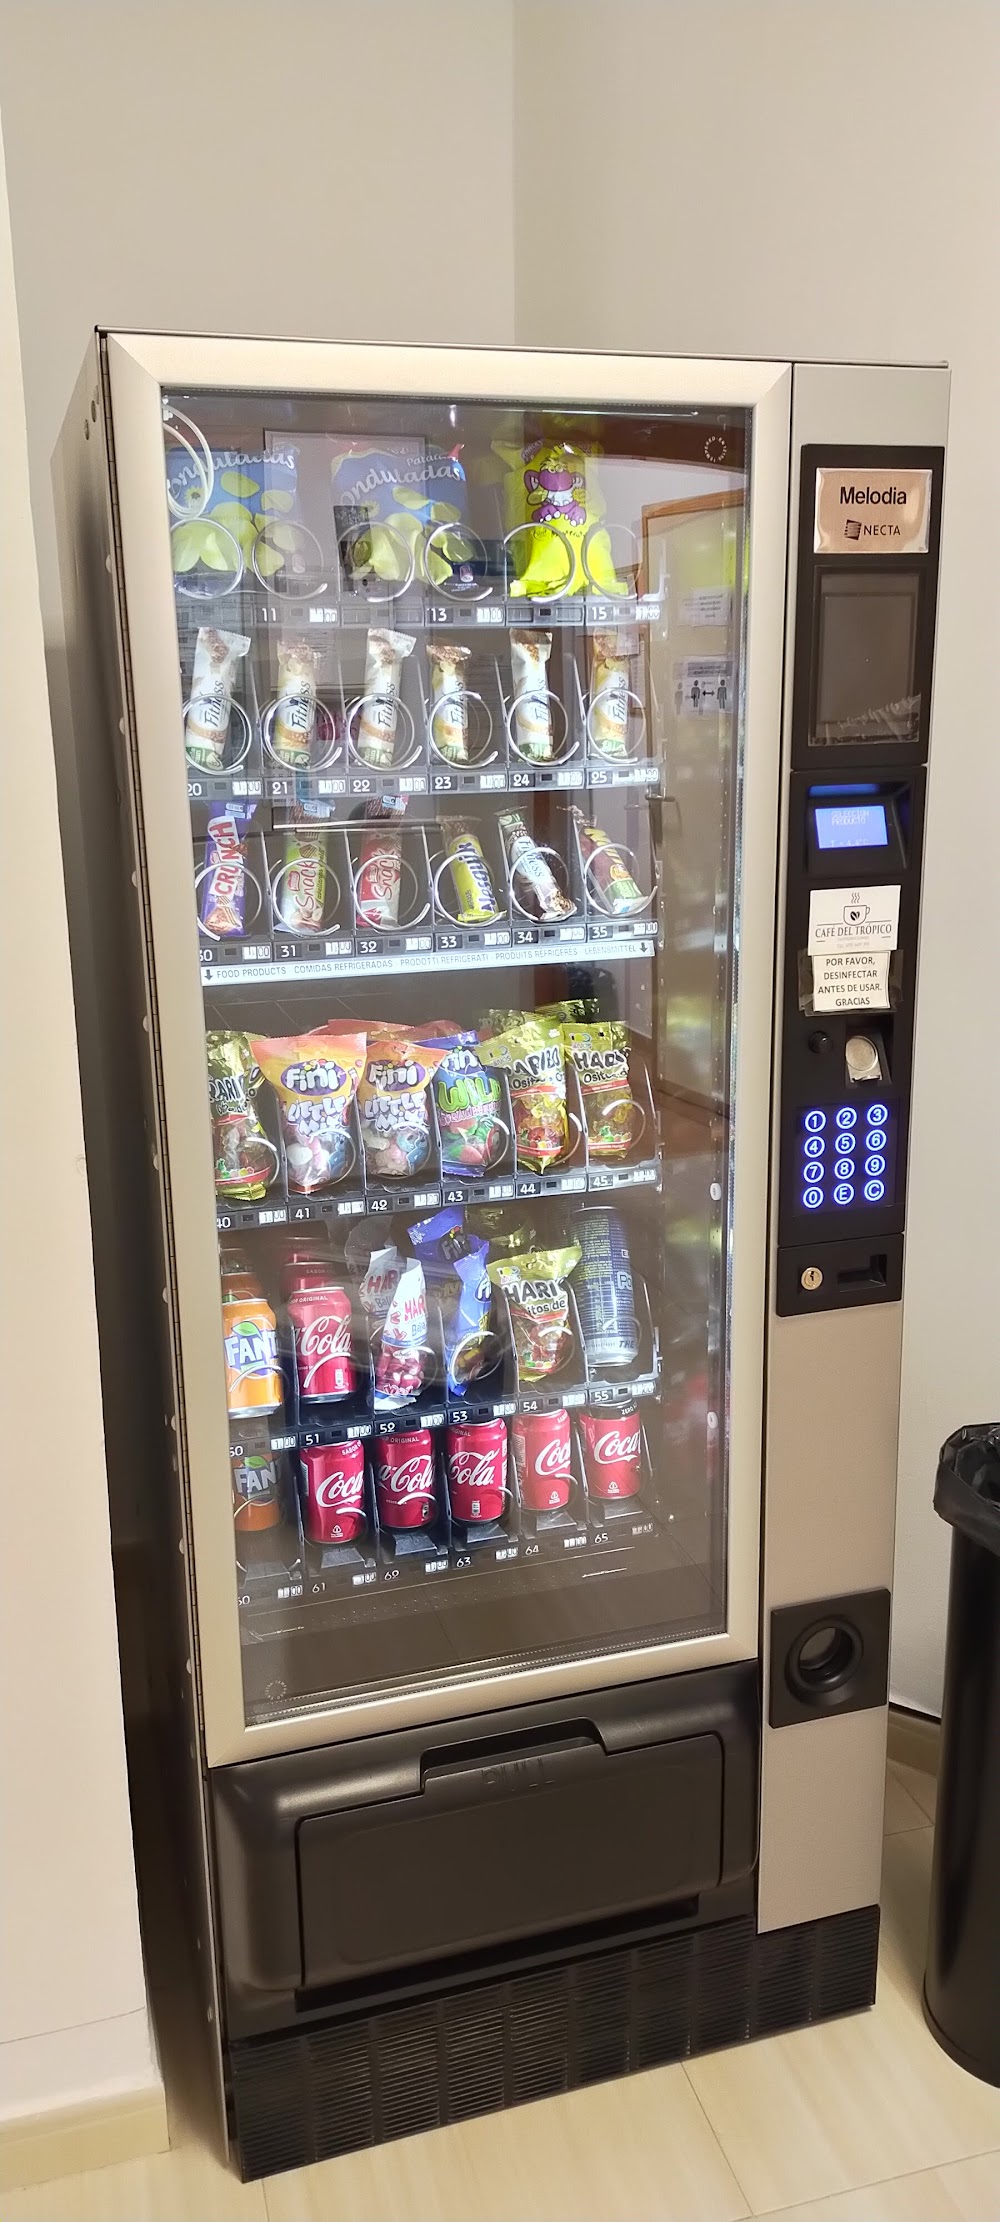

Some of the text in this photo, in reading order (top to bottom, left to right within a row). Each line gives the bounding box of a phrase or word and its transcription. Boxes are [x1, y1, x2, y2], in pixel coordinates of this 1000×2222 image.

[839, 486, 907, 505] Melodia
[864, 524, 901, 536] NECTA
[262, 607, 277, 622] 11
[430, 607, 448, 622] 13
[591, 607, 607, 620] 15
[435, 776, 451, 790] 23
[513, 773, 530, 787] 24
[591, 771, 607, 784] 25
[272, 782, 288, 794] 21
[353, 780, 370, 793] 22
[209, 821, 240, 895] CRUNCH
[374, 856, 394, 901] Snac
[592, 927, 607, 938] 35
[815, 922, 892, 938] CAFÉ DEL TRÓPICO
[440, 936, 457, 949] 33
[517, 931, 533, 944] 34
[281, 945, 296, 957] 31
[360, 941, 377, 953] 32
[216, 969, 239, 979] FOOD
[242, 967, 286, 977] PRODUCTS
[294, 963, 332, 974] COMIDAS
[334, 960, 393, 971] REFRIGERADAS
[400, 957, 439, 967] PRODOTTI
[441, 953, 489, 964] REFRIGERATI
[495, 949, 533, 960] PRODUITS
[585, 943, 636, 955] LEBENSMITTEL
[825, 956, 876, 967] POR FAVOR,
[823, 970, 878, 980] DESINFECTAR
[818, 983, 882, 993] ANTES DE USAR.
[835, 997, 870, 1006] GRACIAS
[286, 1063, 338, 1092] Fini
[369, 1063, 418, 1090] Fini
[438, 1078, 501, 1113] WILD
[287, 1092, 347, 1122] LITTLE
[364, 1091, 426, 1119] LITTLE
[842, 1112, 851, 1125] 2
[873, 1108, 882, 1121] 3
[812, 1115, 818, 1127] 1
[841, 1137, 850, 1150] 5
[872, 1134, 880, 1146] 6
[810, 1141, 819, 1153] 4
[840, 1162, 849, 1175] 8
[870, 1159, 879, 1172] 9
[809, 1166, 818, 1178] 7
[593, 1176, 607, 1187] 45
[520, 1183, 536, 1194] 44
[840, 1188, 848, 1200] E
[869, 1184, 879, 1197] C
[447, 1191, 463, 1203] 43
[809, 1191, 817, 1204] 0
[371, 1199, 388, 1212] 42
[295, 1207, 310, 1219] 41
[552, 1298, 566, 1310] de
[224, 1330, 277, 1367] FANT
[619, 1339, 636, 1350] THE
[594, 1390, 609, 1401] 55
[523, 1401, 538, 1412] 54
[621, 1405, 634, 1416] ZERO
[452, 1411, 468, 1422] 53
[380, 1422, 396, 1433] 52
[305, 1433, 320, 1445] 51
[342, 1446, 358, 1456] SABOR
[593, 1430, 637, 1465] Coca
[316, 1471, 364, 1507] Coca
[594, 1533, 609, 1544] 65
[525, 1544, 540, 1556] 64
[456, 1556, 471, 1568] 63
[384, 1569, 400, 1580] 62
[312, 1582, 326, 1594] 61
